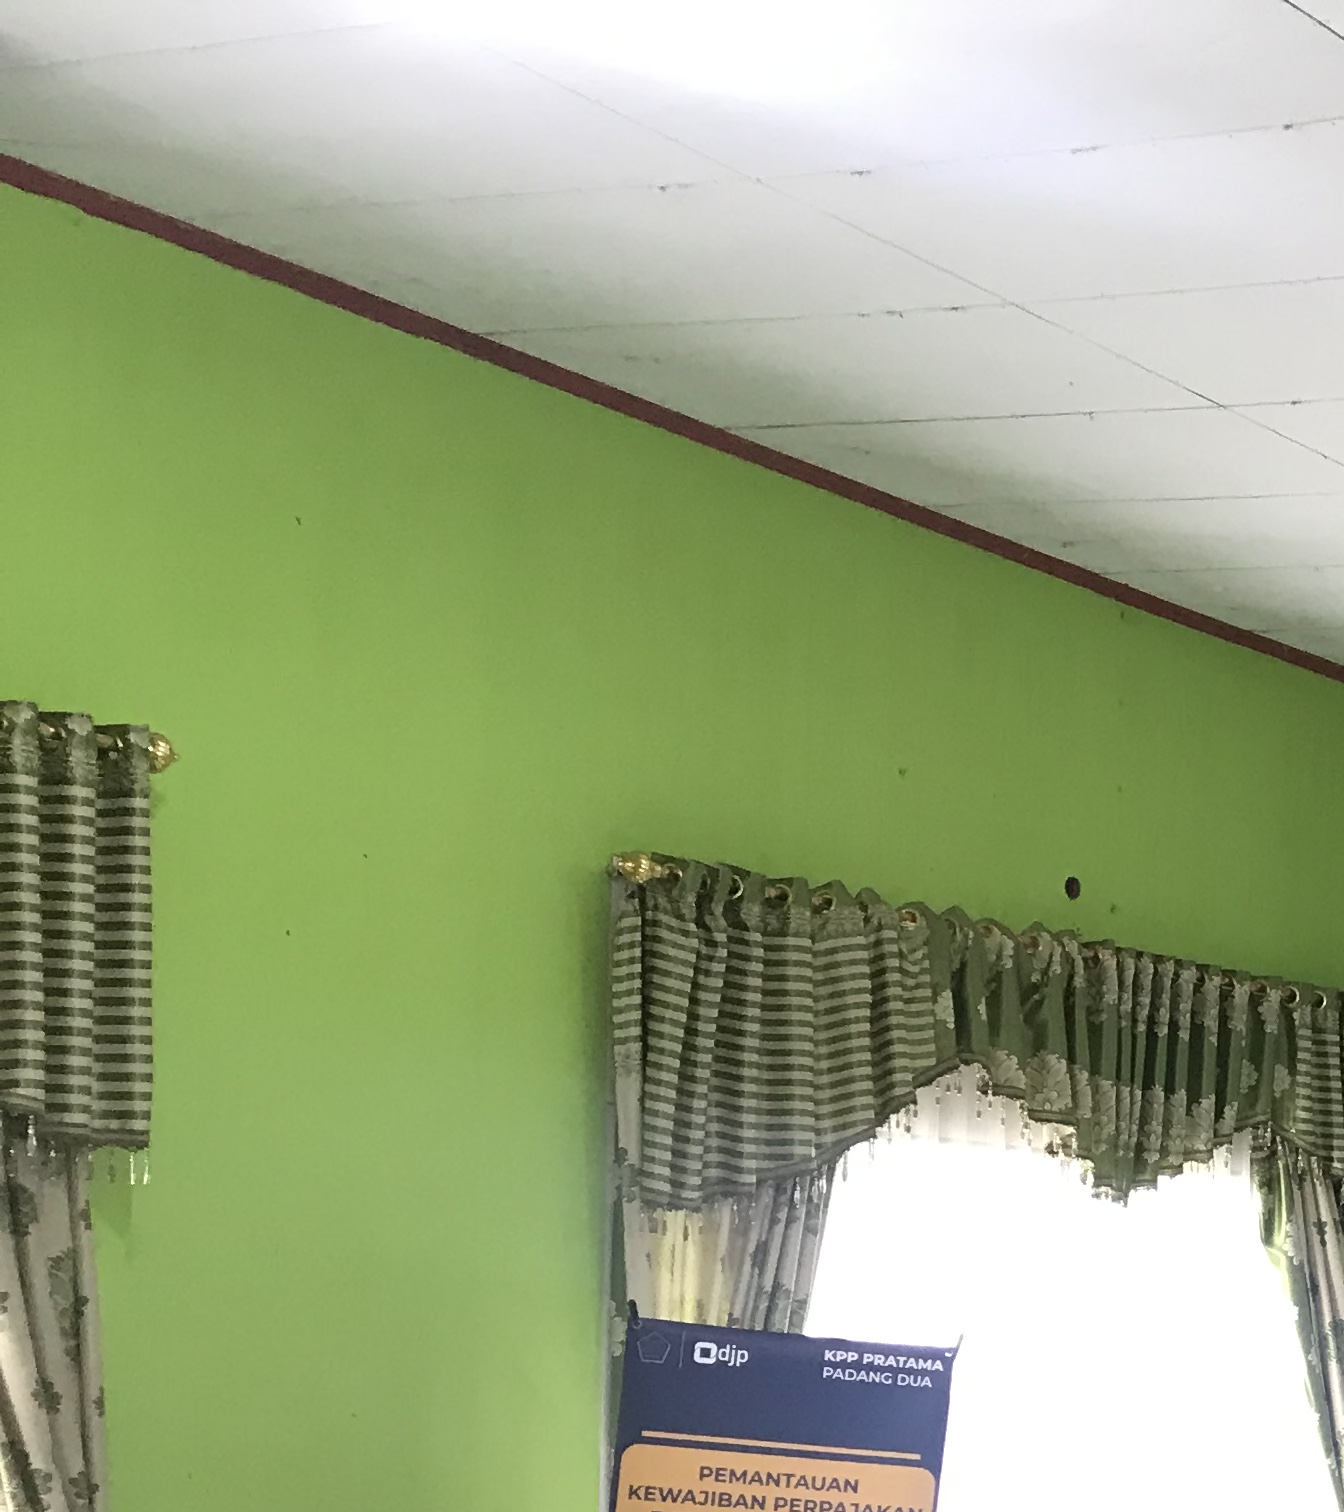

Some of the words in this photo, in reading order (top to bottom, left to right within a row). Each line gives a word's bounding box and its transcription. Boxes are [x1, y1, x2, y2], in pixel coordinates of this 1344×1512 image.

[718, 1344, 749, 1367] djp
[823, 1349, 859, 1363] KPP
[862, 1353, 944, 1371] PRATAMA
[822, 1366, 892, 1385] PADANG
[897, 1374, 933, 1388] DUA
[699, 1465, 859, 1494] PEMANTAUAN
[628, 1484, 766, 1511] KEWAJIBAN
